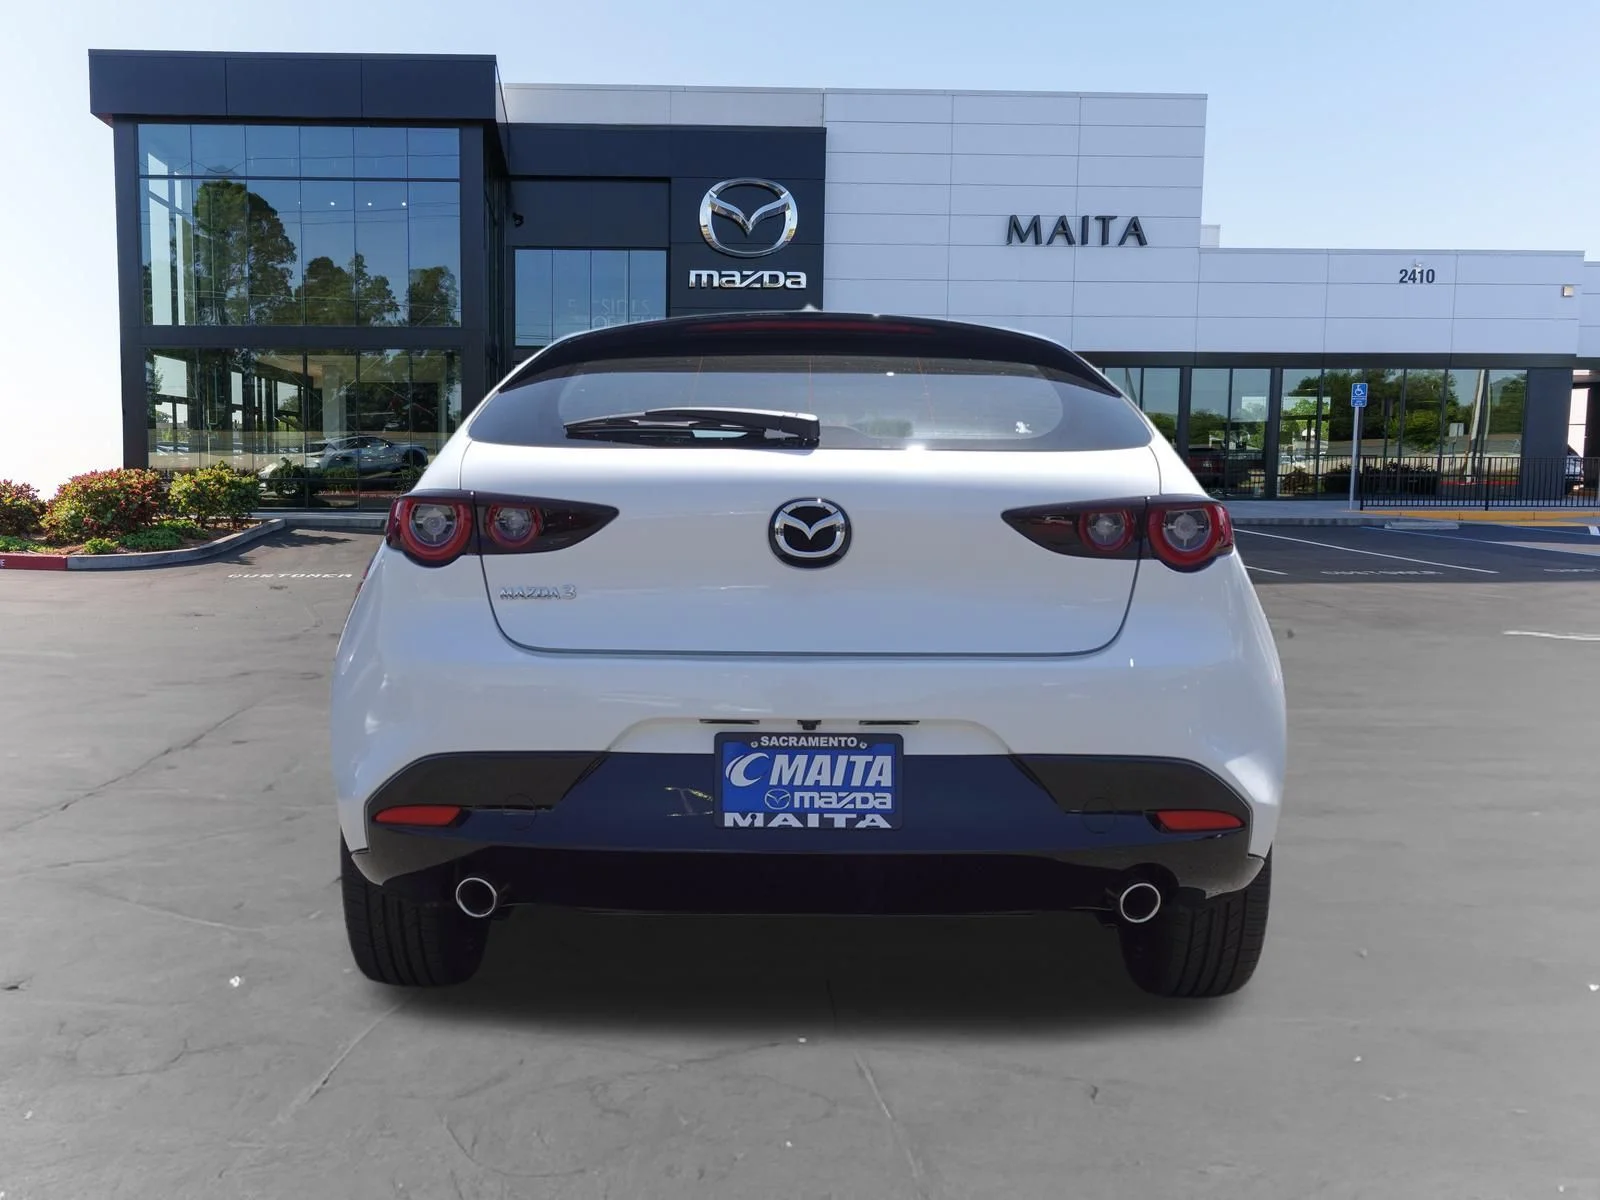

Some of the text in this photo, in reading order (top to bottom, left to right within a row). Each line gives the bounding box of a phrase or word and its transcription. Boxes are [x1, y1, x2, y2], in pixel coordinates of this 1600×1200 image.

[1006, 214, 1148, 246] MAITA
[1399, 268, 1435, 284] 2410
[760, 736, 858, 748] SACRAMENTO
[769, 754, 892, 787] MAITA
[724, 812, 892, 828] MAITA
